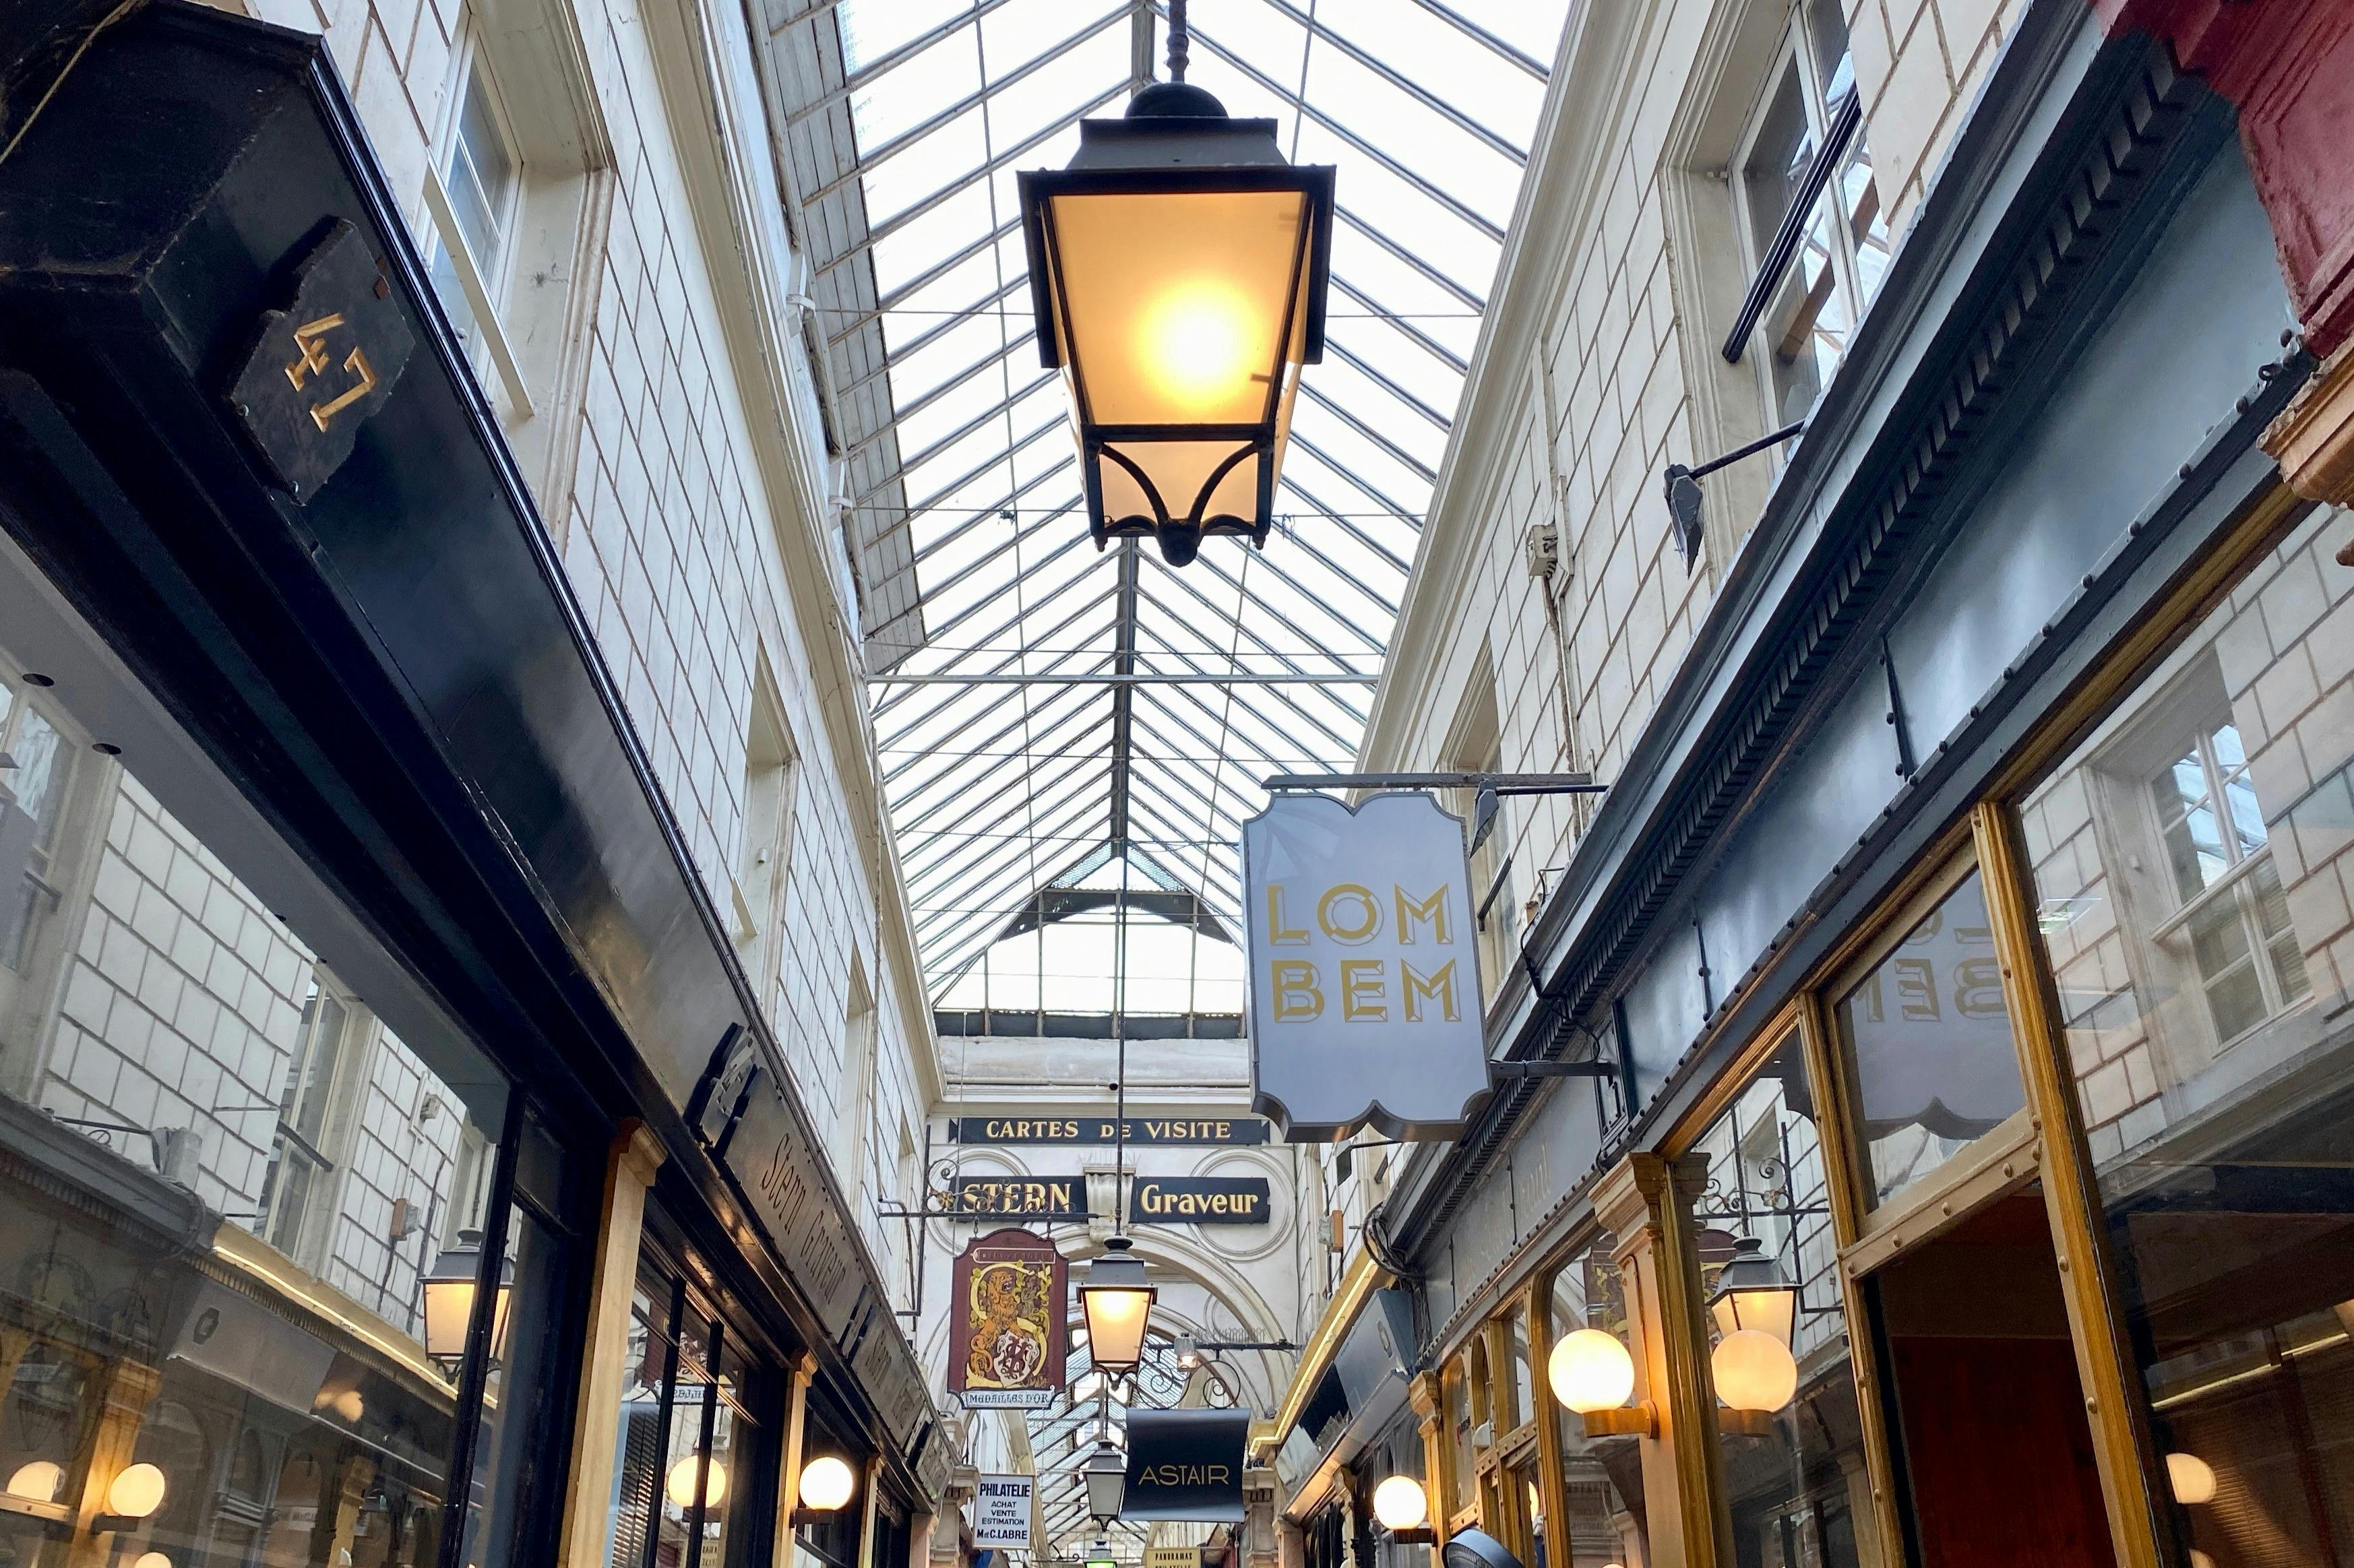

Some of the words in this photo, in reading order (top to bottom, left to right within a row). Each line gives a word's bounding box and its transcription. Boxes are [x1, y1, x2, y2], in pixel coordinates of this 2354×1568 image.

[1267, 883, 1454, 946] LOM
[1271, 958, 1462, 1024] BEM
[986, 1121, 1078, 1138] CARTES
[1100, 1125, 1132, 1137] DE
[1145, 1121, 1231, 1139] VISITE
[963, 1183, 1072, 1213] STERN
[1140, 1185, 1258, 1215] Graveur
[760, 1133, 807, 1235] Stern
[800, 1210, 846, 1305] Graveur
[1026, 1393, 1049, 1404] D'OR
[1138, 1465, 1229, 1485] ASTAIR
[979, 1483, 1030, 1497] PHILATELIE
[982, 1517, 1024, 1526] ESTIMATION
[1155, 1553, 1193, 1561] PANORAMAS
